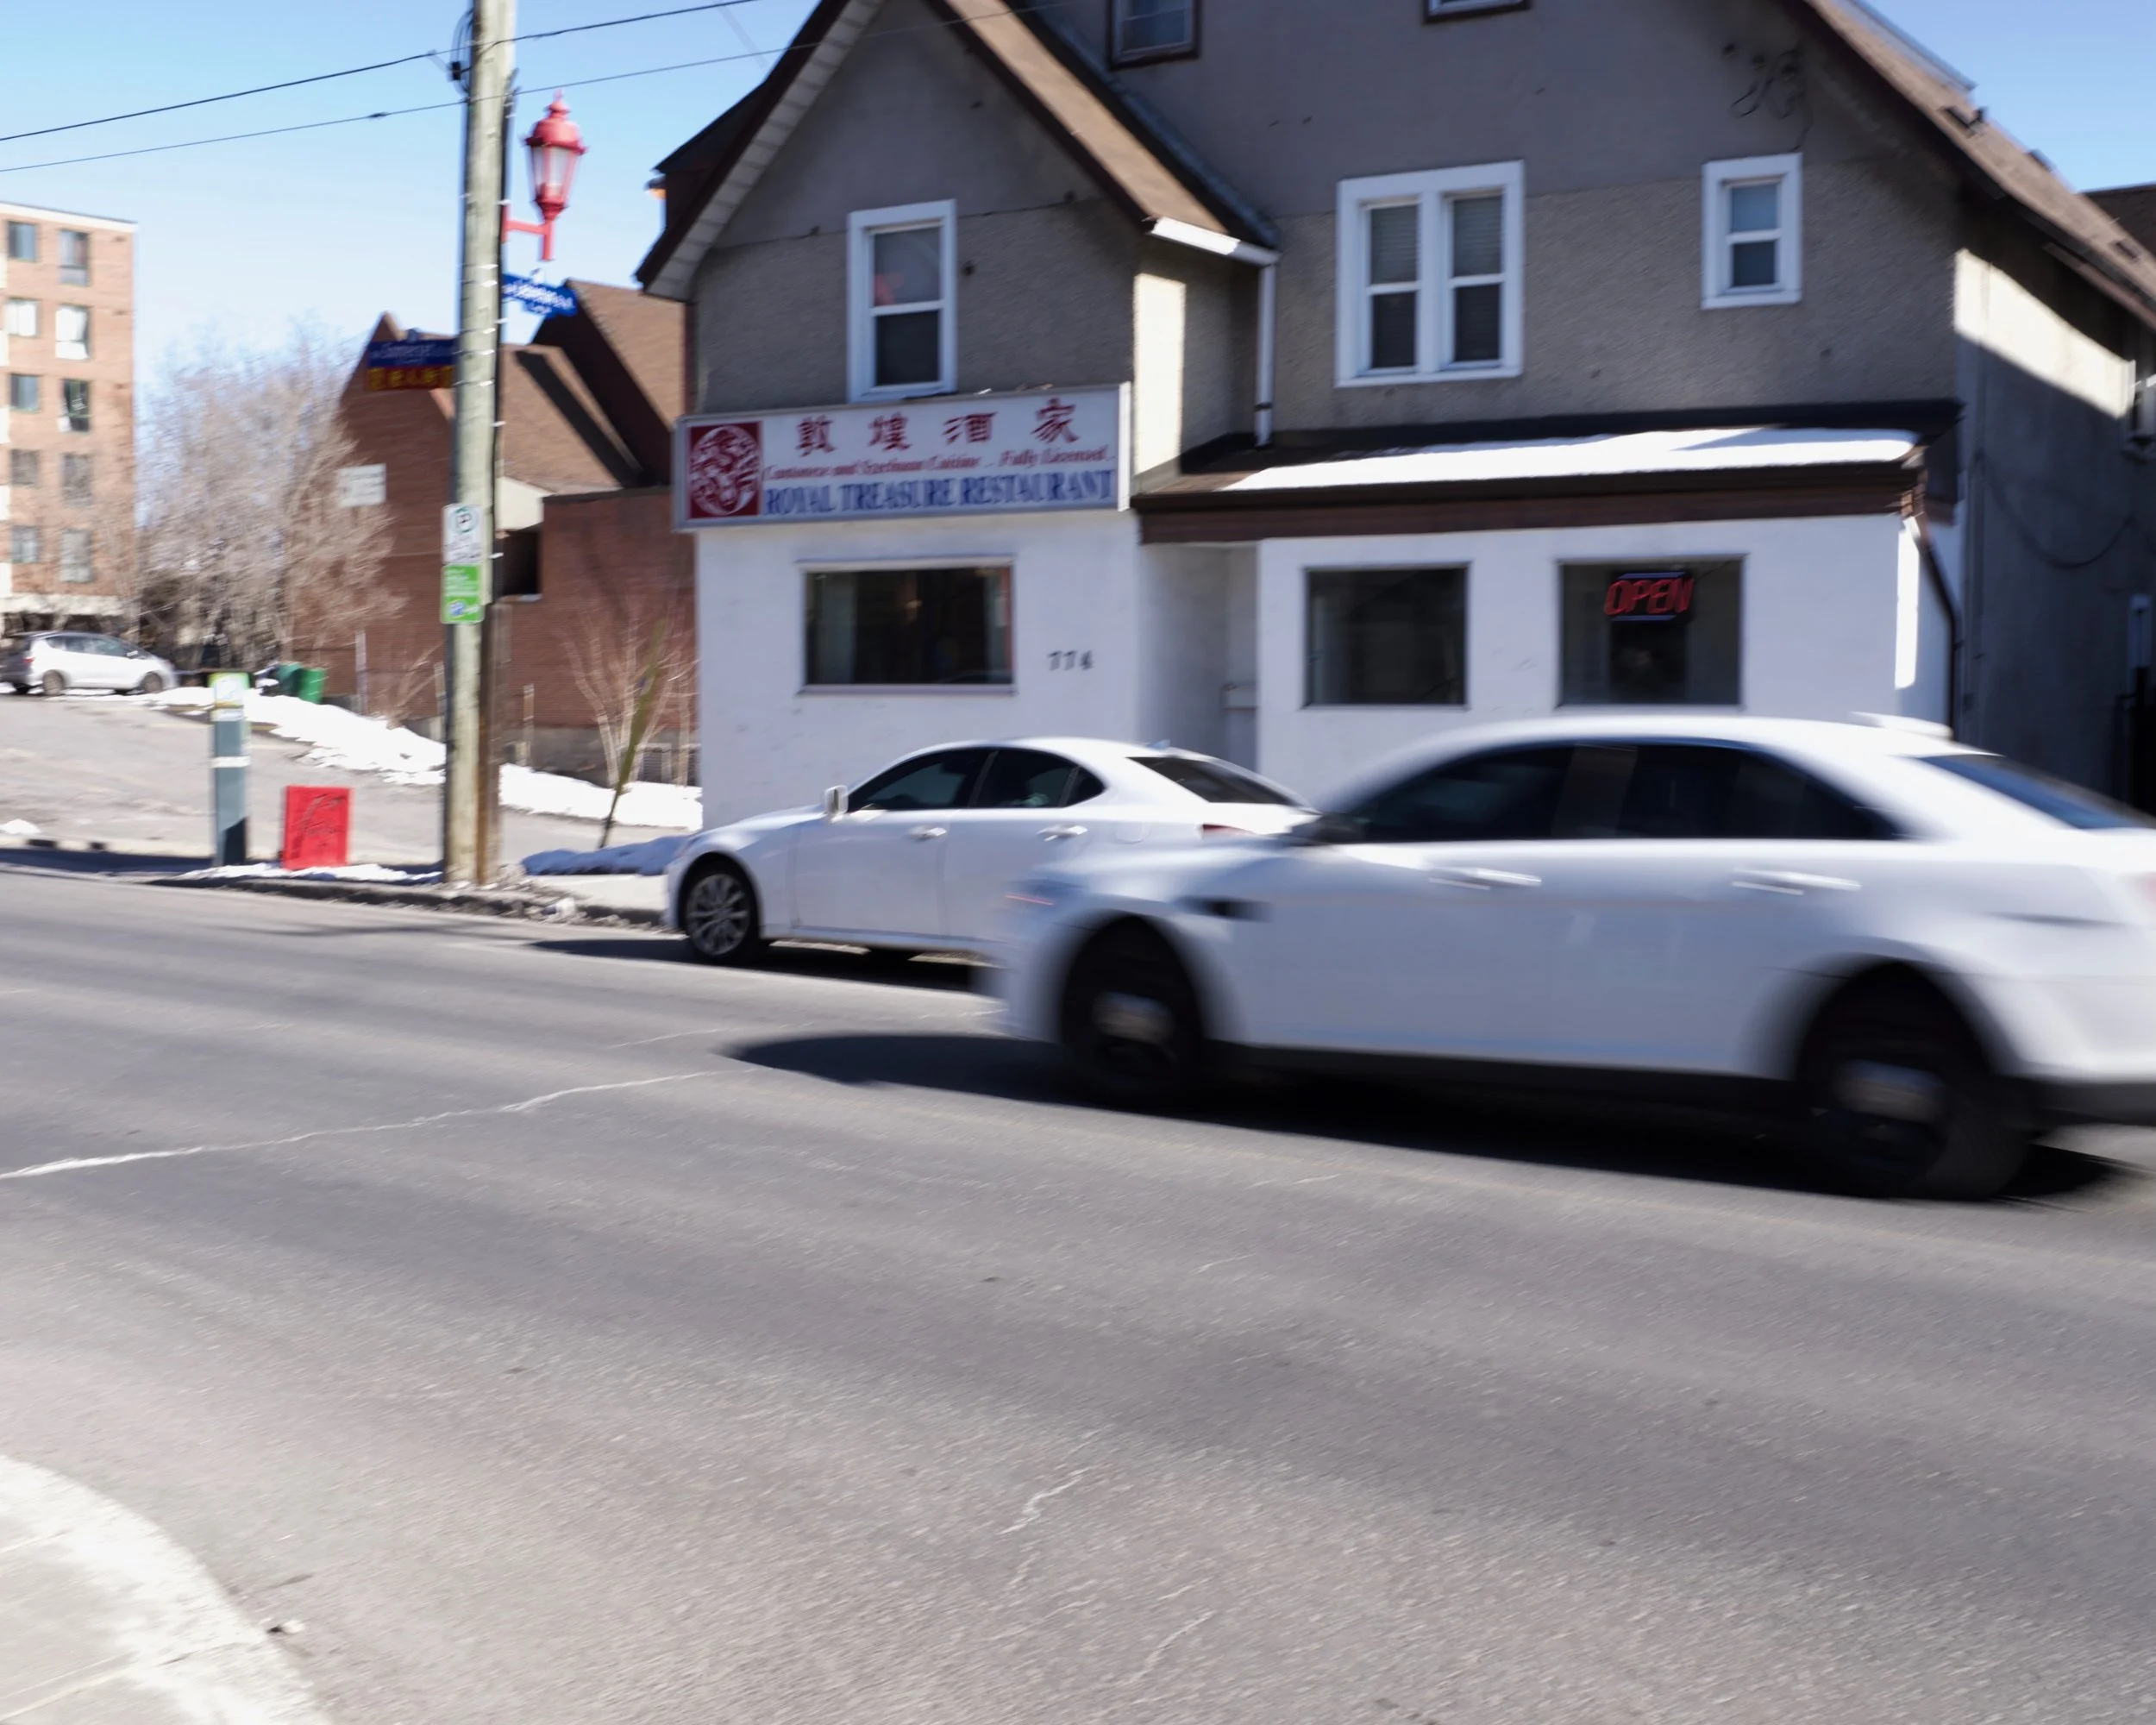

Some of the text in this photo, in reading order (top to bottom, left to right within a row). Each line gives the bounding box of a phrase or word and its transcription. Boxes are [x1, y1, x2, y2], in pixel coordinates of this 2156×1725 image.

[795, 398, 1081, 457] 敦煌酒家
[1000, 448, 1037, 469] Fully
[764, 469, 1114, 515] ROYAL TREASURE RESTAURANT
[1604, 578, 1695, 616] OPEN
